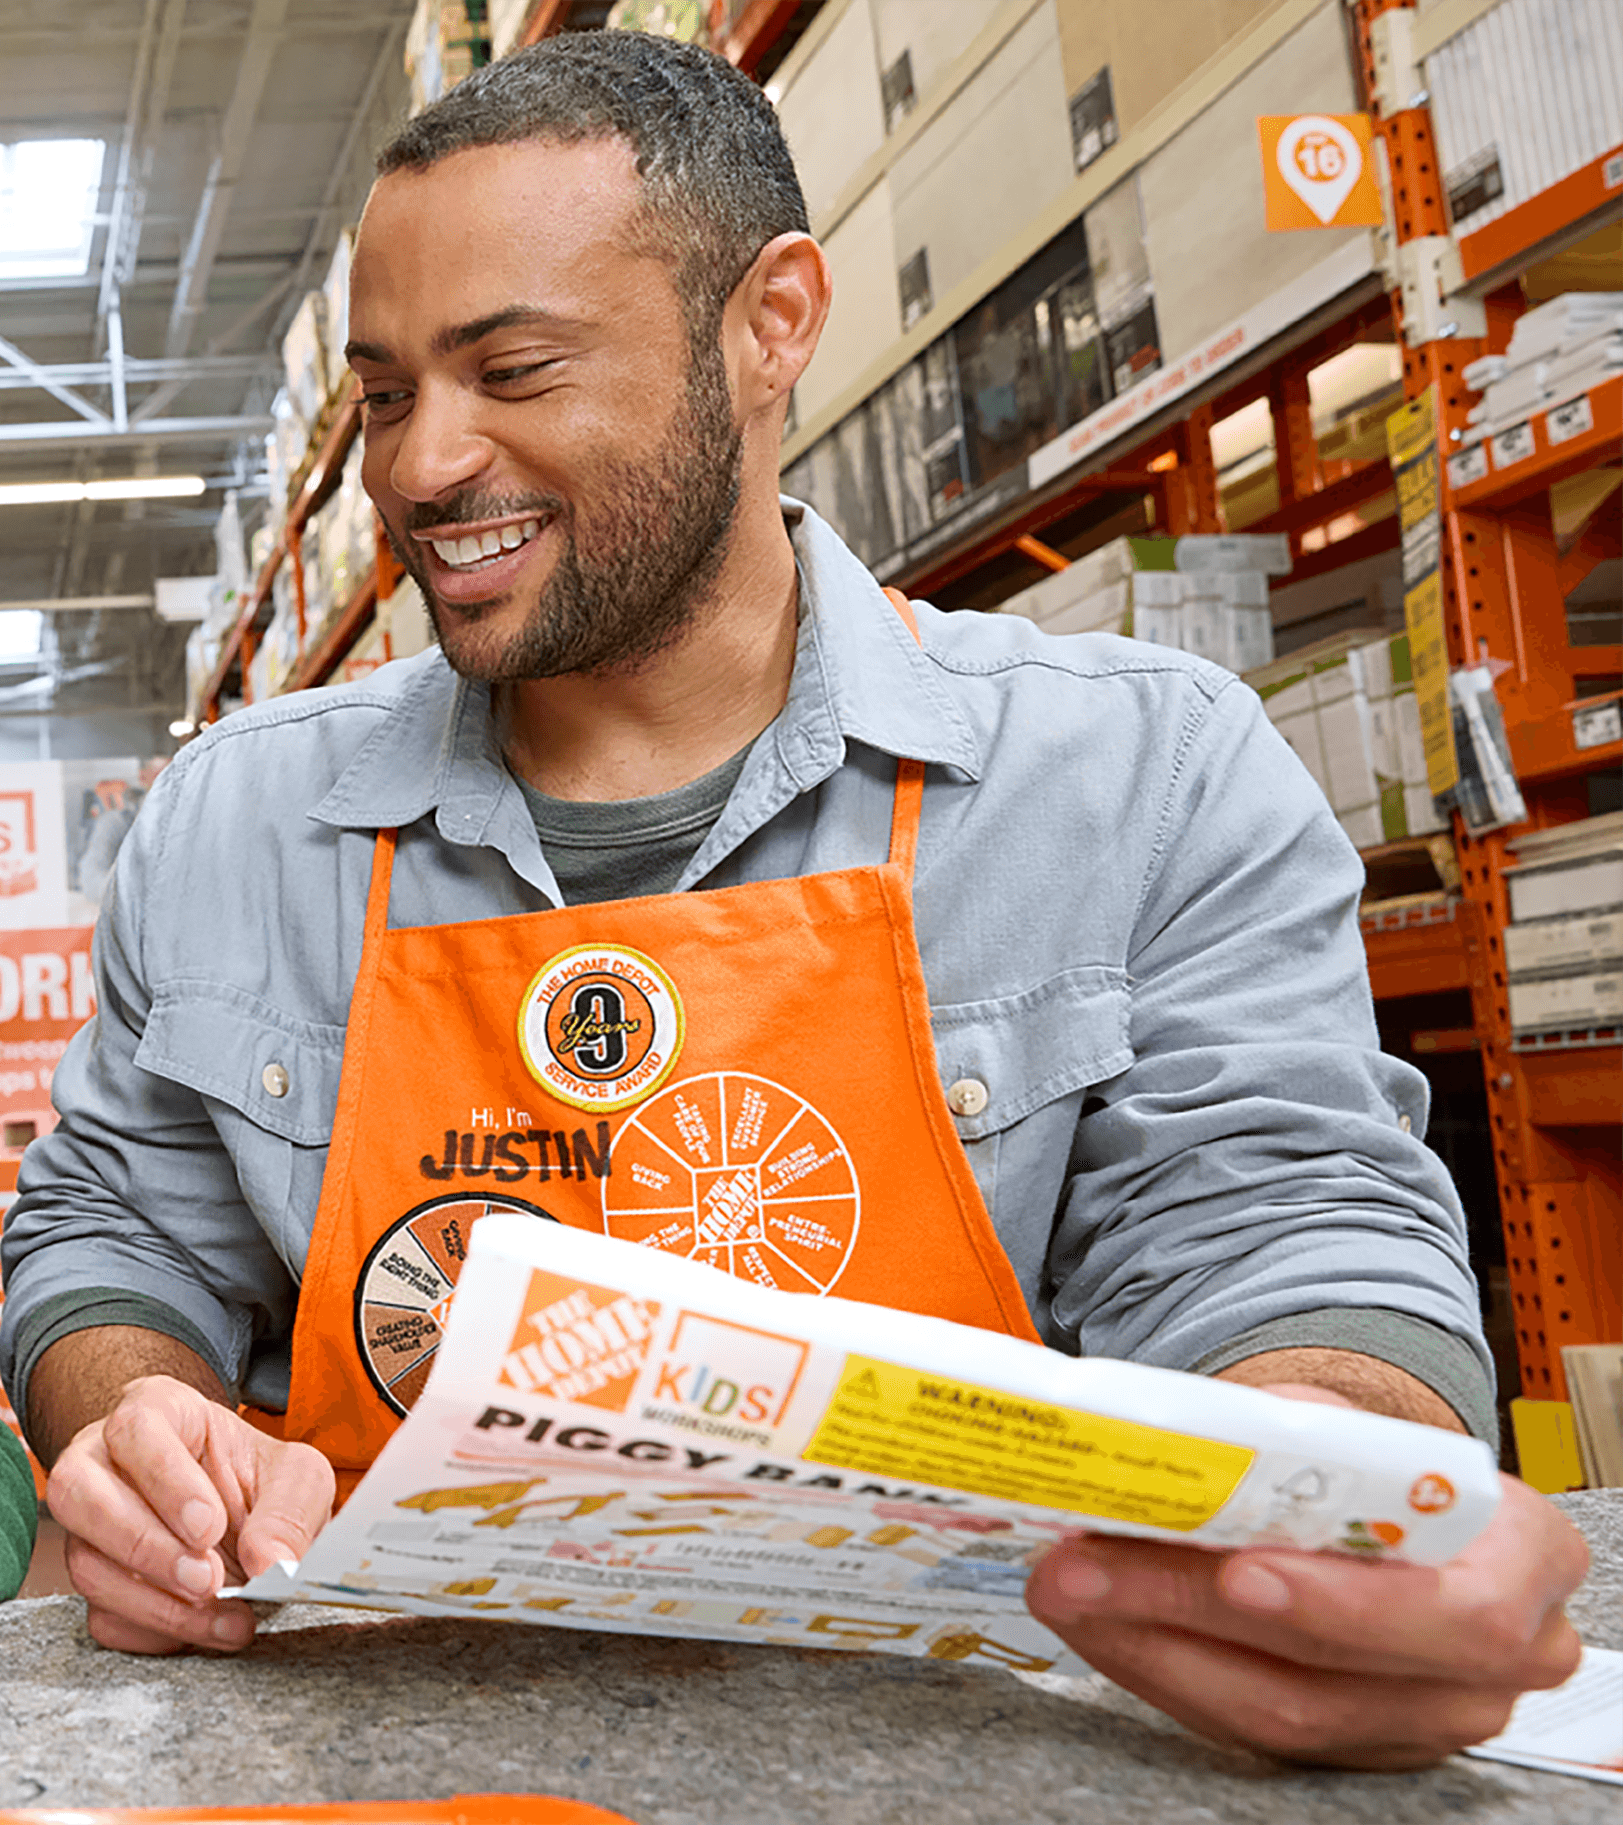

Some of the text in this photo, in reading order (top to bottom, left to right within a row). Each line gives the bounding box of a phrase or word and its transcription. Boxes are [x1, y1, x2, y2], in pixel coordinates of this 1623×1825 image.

[1298, 145, 1342, 176] 16
[537, 957, 662, 1005] THE HOME DEPOT
[557, 1011, 642, 1055] Years
[572, 983, 626, 1072] 9
[544, 1050, 663, 1098] SERVICE AWARD
[471, 1107, 533, 1130] Hi, I'm
[674, 1094, 693, 1122] CARE
[689, 1103, 712, 1143] TAKING
[731, 1086, 753, 1149] EXCELLENT
[738, 1091, 762, 1150] CUSTOMER
[749, 1101, 769, 1146] SERVICE
[419, 1121, 613, 1183] JUSTIN
[673, 1112, 696, 1152] PEOPLE
[631, 1162, 671, 1184] GIVING
[762, 1147, 844, 1198] RELATIONSHIPS
[767, 1142, 815, 1174] BUILDING
[777, 1151, 818, 1178] STRONG
[632, 1173, 663, 1191] BACK
[702, 1175, 729, 1208] THE
[698, 1168, 759, 1243] HOME
[784, 1232, 823, 1251] SPIRIT
[376, 1316, 423, 1336] CREATING
[527, 1288, 589, 1335] THE
[369, 1322, 436, 1349] SHAREHOLDER
[389, 1338, 422, 1354] VALUE
[503, 1297, 653, 1391] HOME
[552, 1348, 649, 1400] DEPOT
[653, 1361, 776, 1423] KIDS
[473, 1404, 735, 1470] PIGGY
